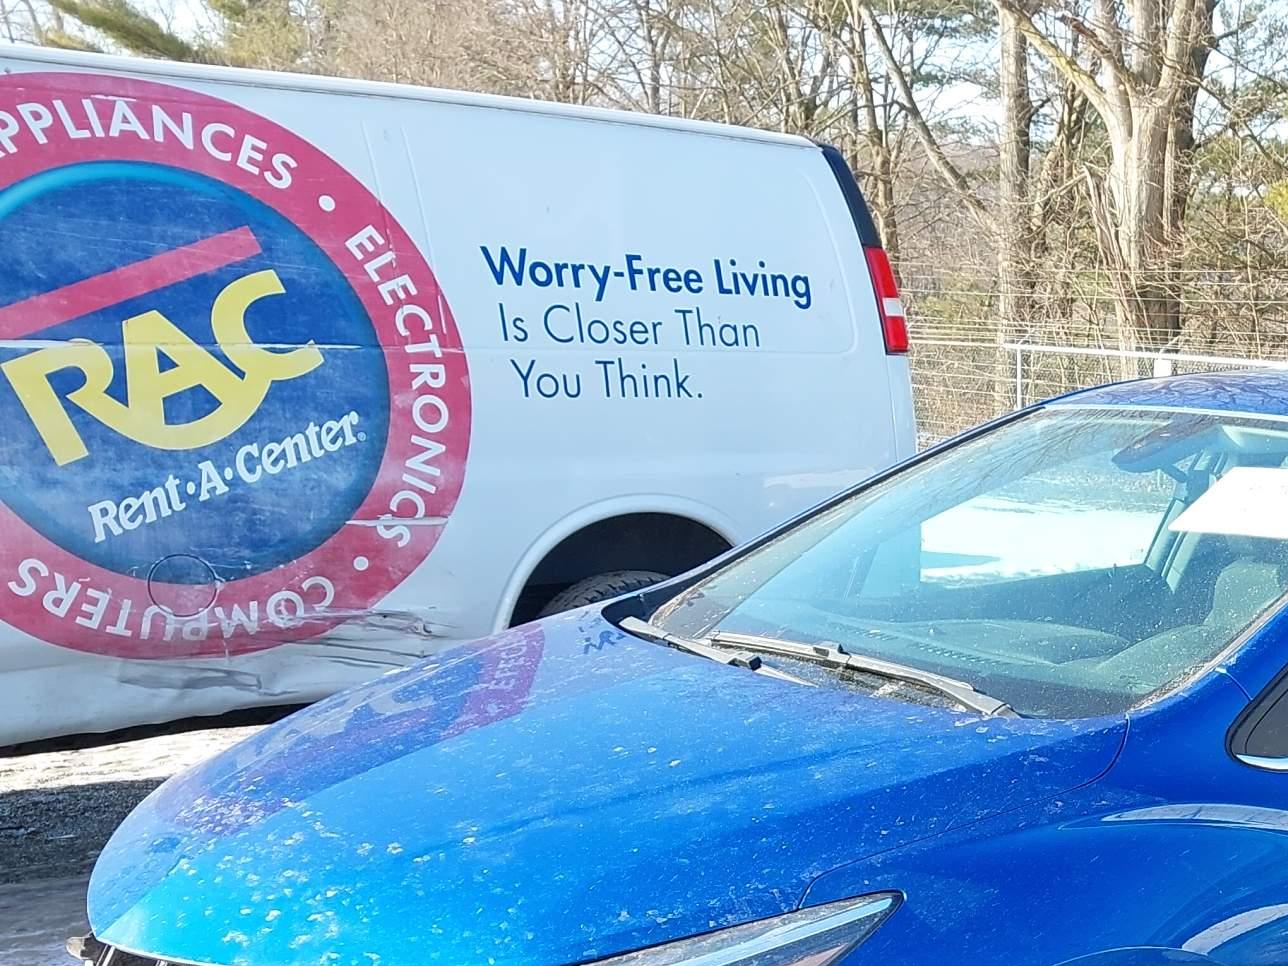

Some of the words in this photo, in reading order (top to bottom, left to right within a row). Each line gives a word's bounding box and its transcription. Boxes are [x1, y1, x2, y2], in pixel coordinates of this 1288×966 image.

[0, 98, 298, 190] PPLIANCES
[479, 245, 704, 302] Worry-Free
[713, 258, 812, 310] Living
[0, 268, 325, 467] RAC
[498, 302, 529, 343] Is
[543, 302, 663, 346] Closer
[674, 306, 760, 348] Than
[345, 224, 450, 548] ELECTRONICS
[510, 358, 582, 399] You
[594, 356, 703, 399] Think.
[7, 557, 336, 642] COMPUTERS
